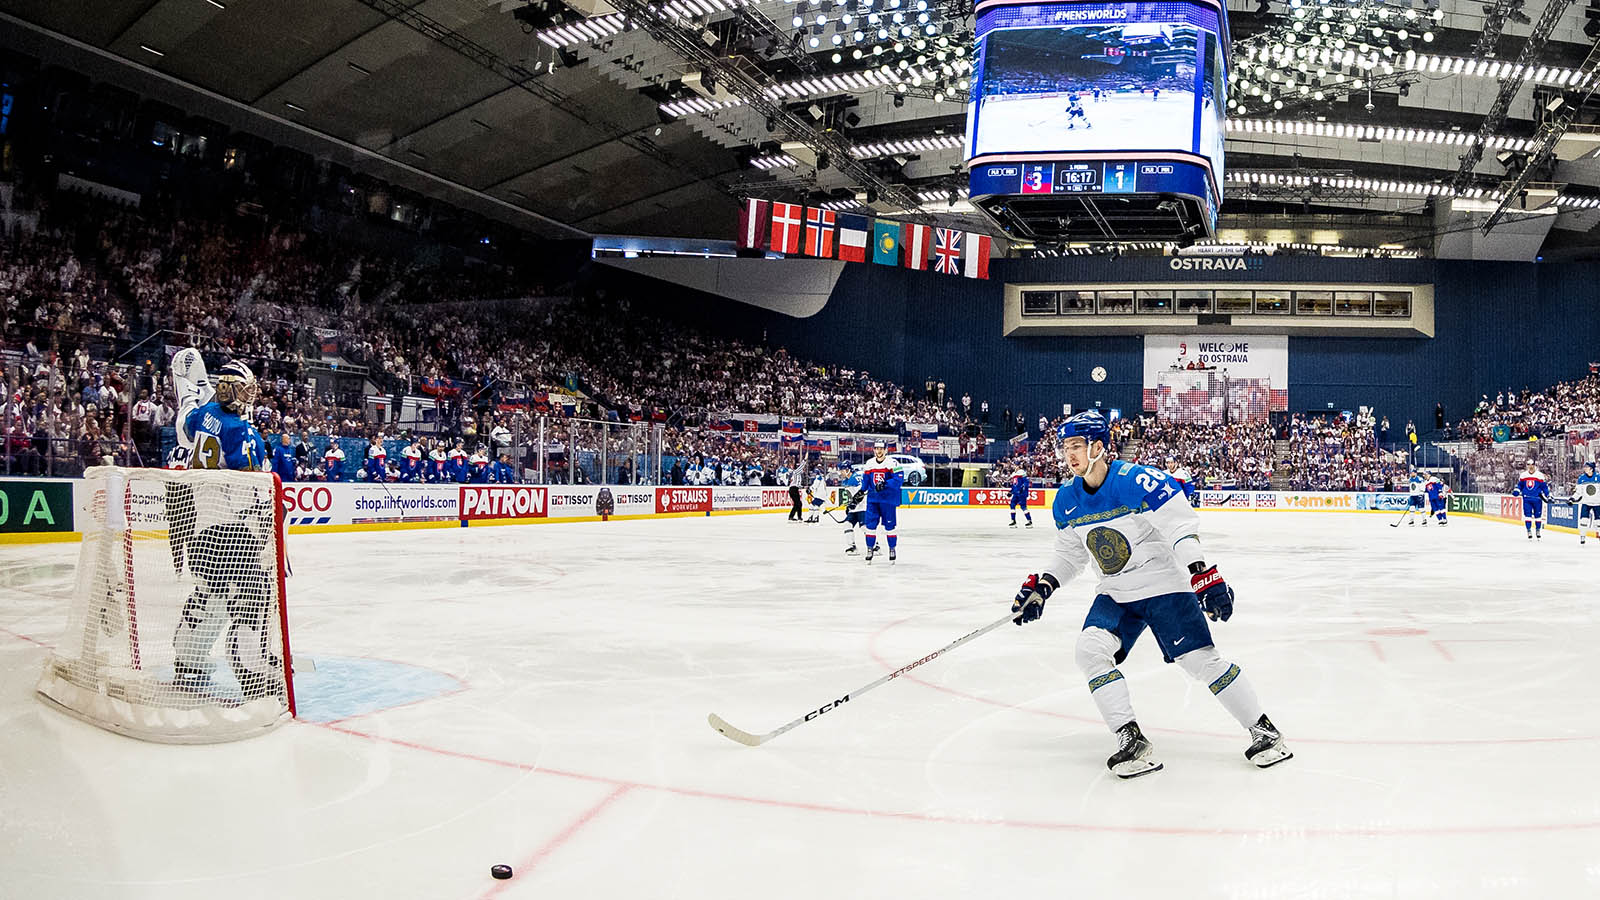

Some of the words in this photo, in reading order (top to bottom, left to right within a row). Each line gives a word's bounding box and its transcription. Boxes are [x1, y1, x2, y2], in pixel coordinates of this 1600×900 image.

[1055, 9, 1127, 20] #MENSWORLDS
[1032, 172, 1042, 190] 3
[1065, 172, 1092, 183] 16:17
[1115, 171, 1124, 189] 1
[1199, 343, 1248, 353] WELCOME
[1199, 354, 1209, 363] TO
[1211, 354, 1248, 363] OSTRAVA
[1136, 467, 1166, 493] 28
[281, 487, 332, 513] SCO
[564, 495, 593, 505] TISSOT
[628, 494, 652, 503] TISSOT
[672, 490, 708, 503] STRAUSS
[762, 490, 801, 507] BAUHA
[918, 490, 963, 504] Tipsport
[990, 490, 1038, 500] STRSS
[1285, 494, 1351, 508] viamont
[355, 496, 456, 512] shop.iihfworlds.com
[463, 488, 545, 517] PATRON
[888, 651, 939, 681] JETSPEED
[805, 694, 850, 722] CCM
